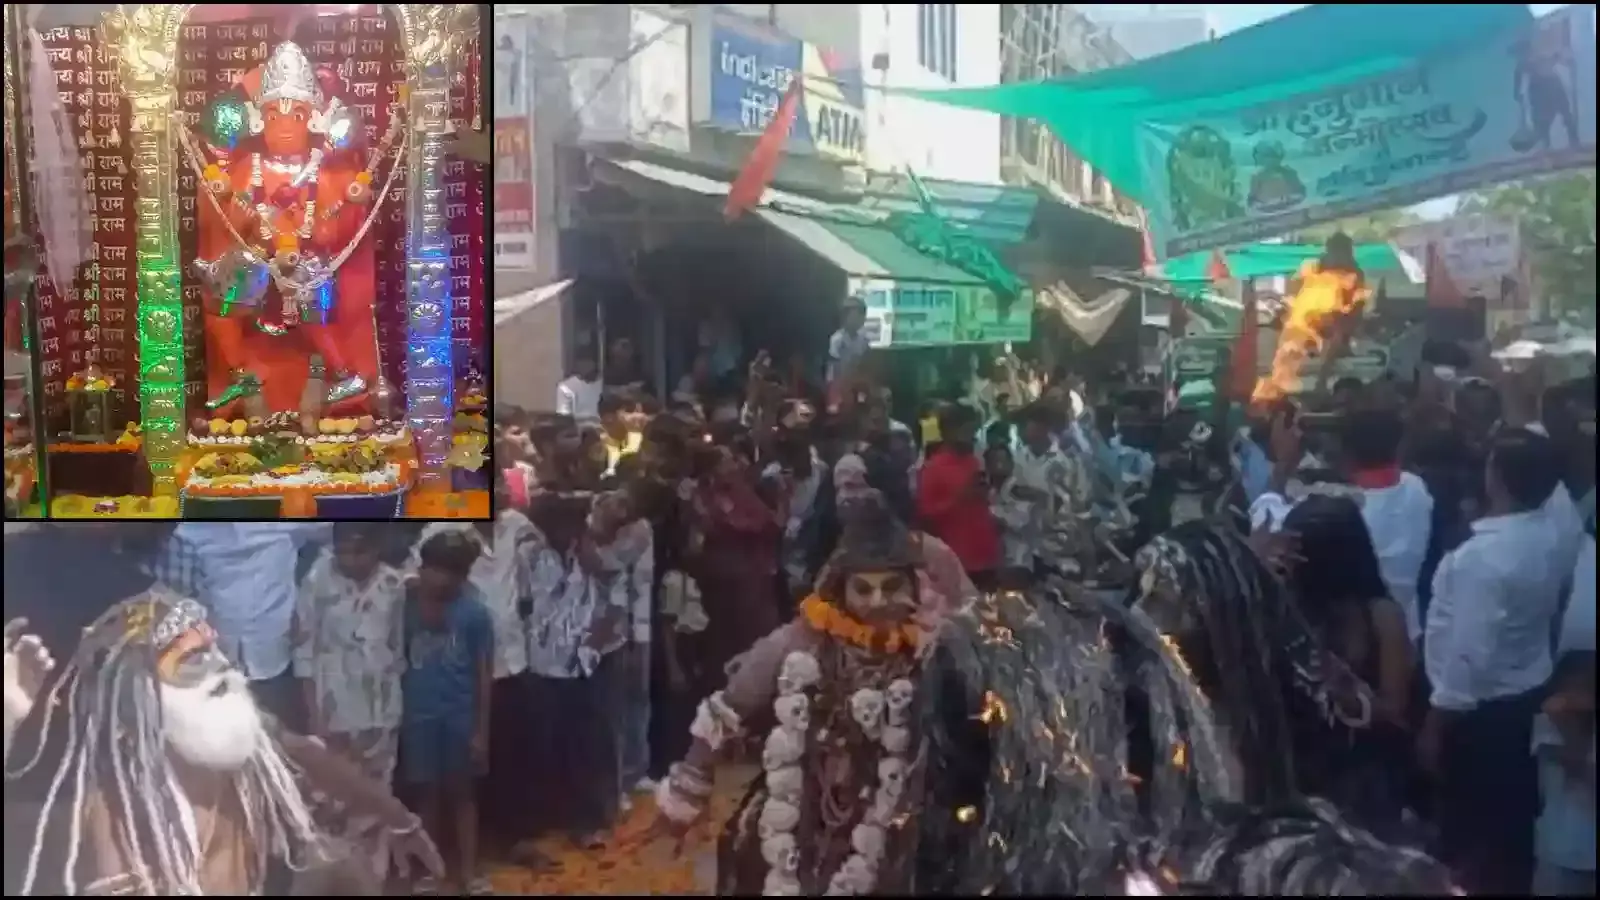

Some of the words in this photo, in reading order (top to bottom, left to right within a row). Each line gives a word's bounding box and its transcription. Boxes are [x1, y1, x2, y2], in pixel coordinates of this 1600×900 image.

[184, 26, 207, 40] राम
[77, 66, 93, 86] श्री
[95, 69, 120, 86] राम
[98, 176, 123, 190] राम
[99, 197, 125, 212] राम
[100, 217, 126, 233] राम
[103, 245, 128, 261] राम
[83, 262, 100, 281] श्री
[103, 267, 126, 281] राम
[83, 283, 100, 301] श्री
[103, 287, 127, 302] राम
[83, 303, 100, 322] श्री
